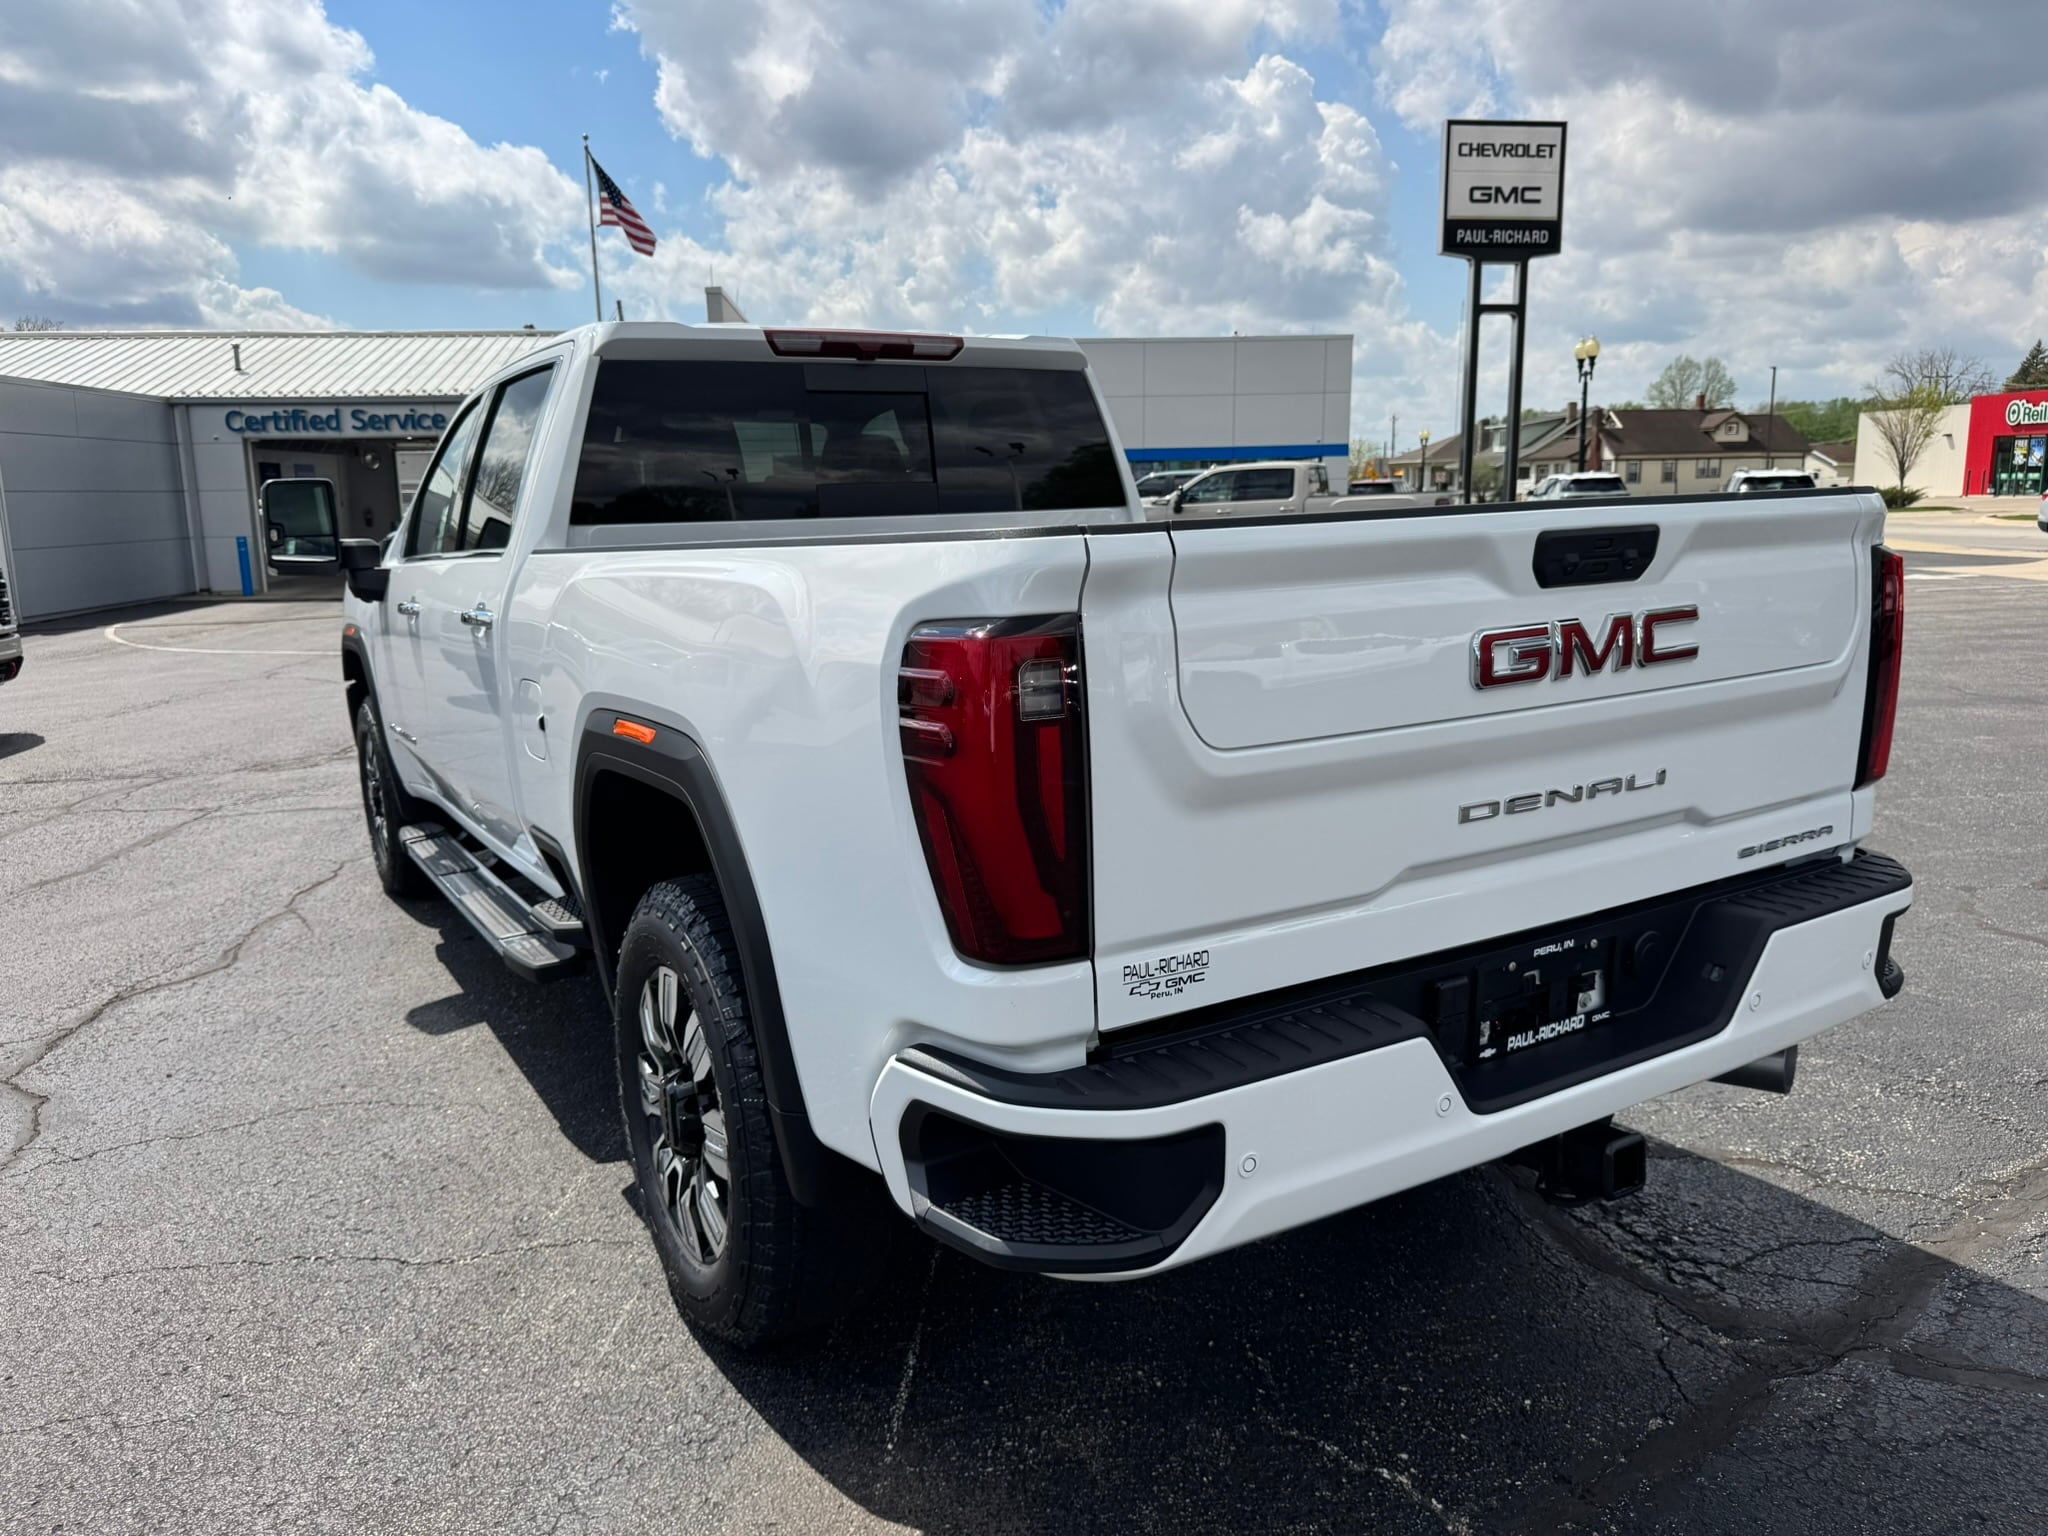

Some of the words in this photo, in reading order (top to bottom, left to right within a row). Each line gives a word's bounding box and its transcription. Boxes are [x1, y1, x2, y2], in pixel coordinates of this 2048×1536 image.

[1458, 142, 1557, 159] CHEVROLET
[1469, 186, 1542, 204] GMC
[1456, 229, 1549, 244] PAUL-RICHARD
[225, 408, 340, 432] Certified
[351, 409, 448, 431] Service
[2007, 401, 2048, 424] O'Reil
[1469, 603, 1699, 691] GMC
[1458, 767, 1667, 824] DENALI
[1737, 824, 1834, 859] SIERRA
[1533, 941, 1562, 958] PERU,
[1563, 938, 1575, 948] IN
[1123, 949, 1210, 982] PAUL-RICHARD
[1165, 971, 1206, 989] GMC
[1150, 990, 1173, 1000] Peru,
[1174, 986, 1184, 995] IN
[1591, 1010, 1611, 1022] GMC
[1506, 1014, 1586, 1051] PAUL-RICHARD
